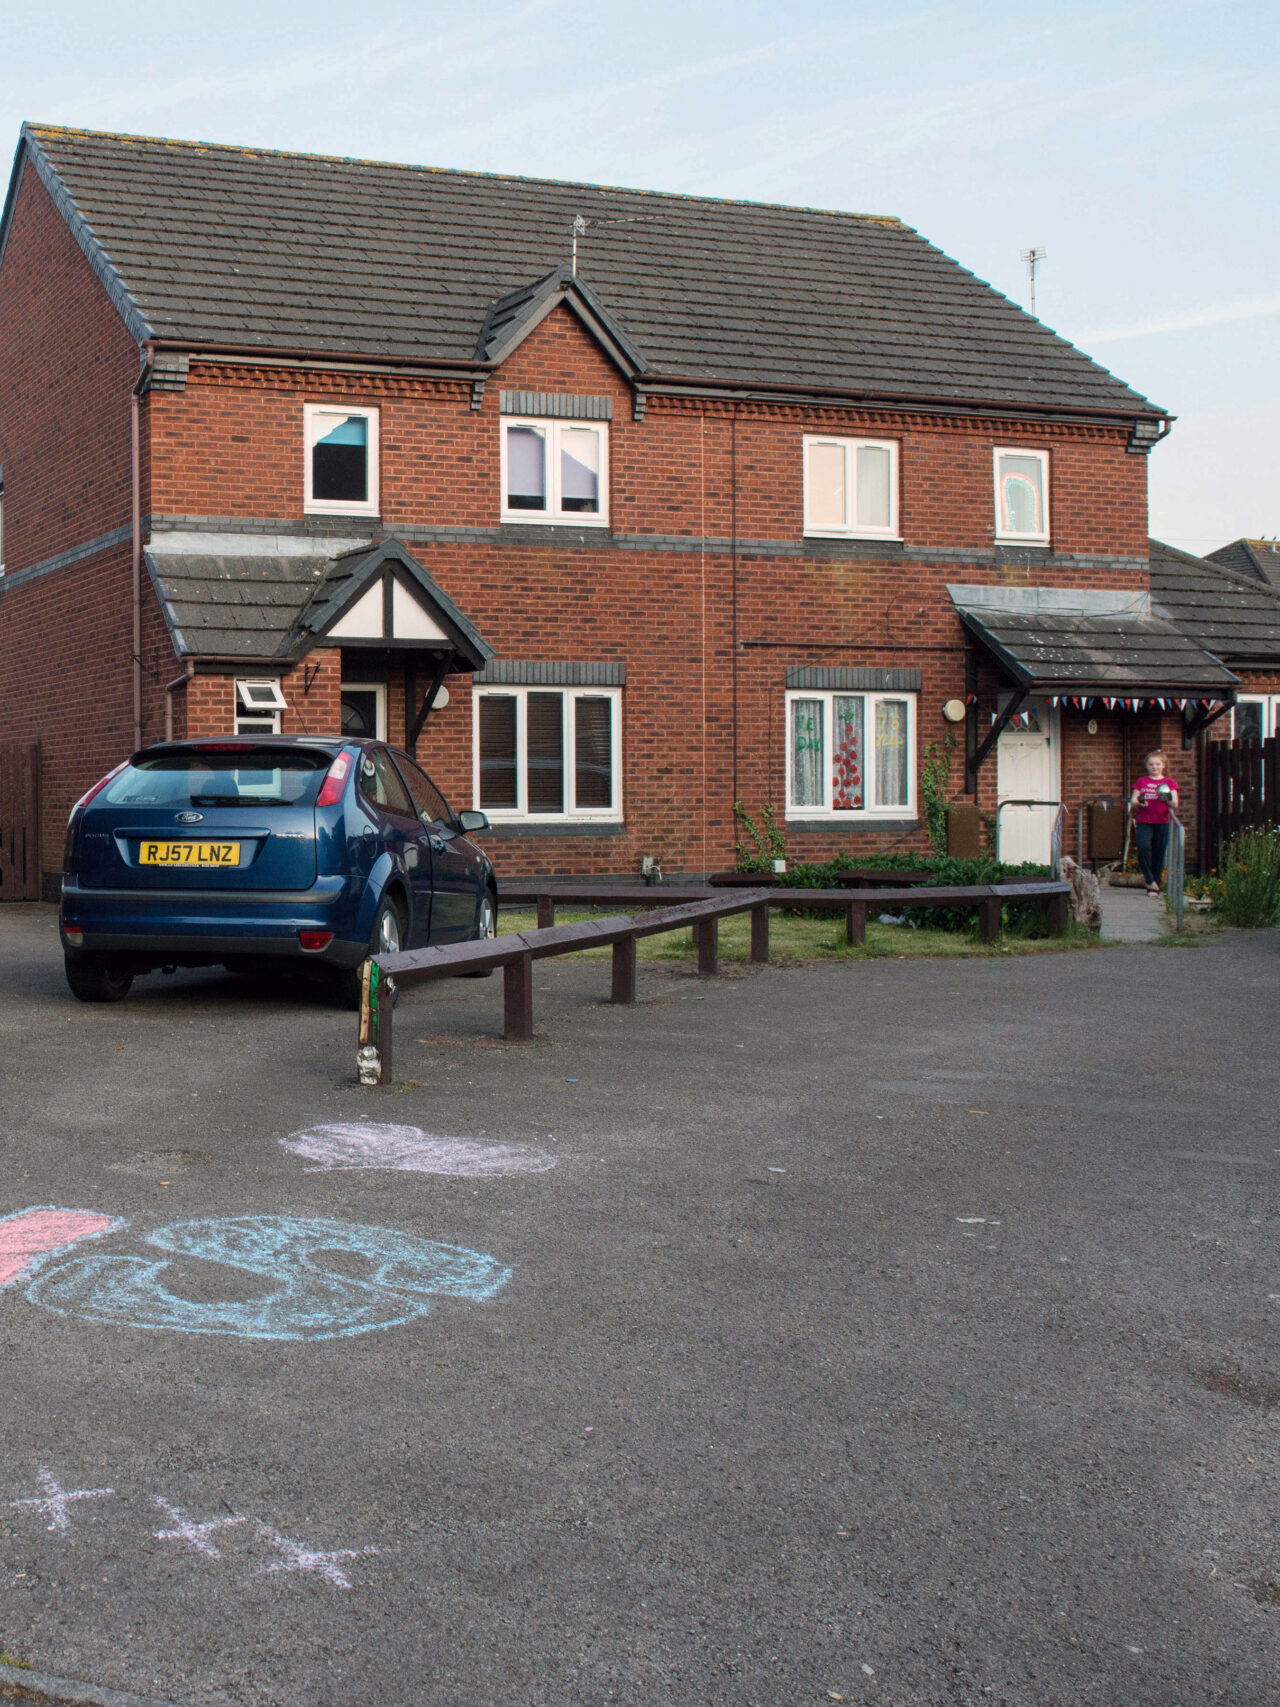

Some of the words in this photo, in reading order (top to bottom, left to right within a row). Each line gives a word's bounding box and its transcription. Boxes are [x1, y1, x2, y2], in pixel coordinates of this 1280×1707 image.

[796, 715, 813, 732] VE
[797, 735, 820, 752] DAY
[147, 845, 193, 862] RJ57
[198, 845, 233, 862] LNZ
